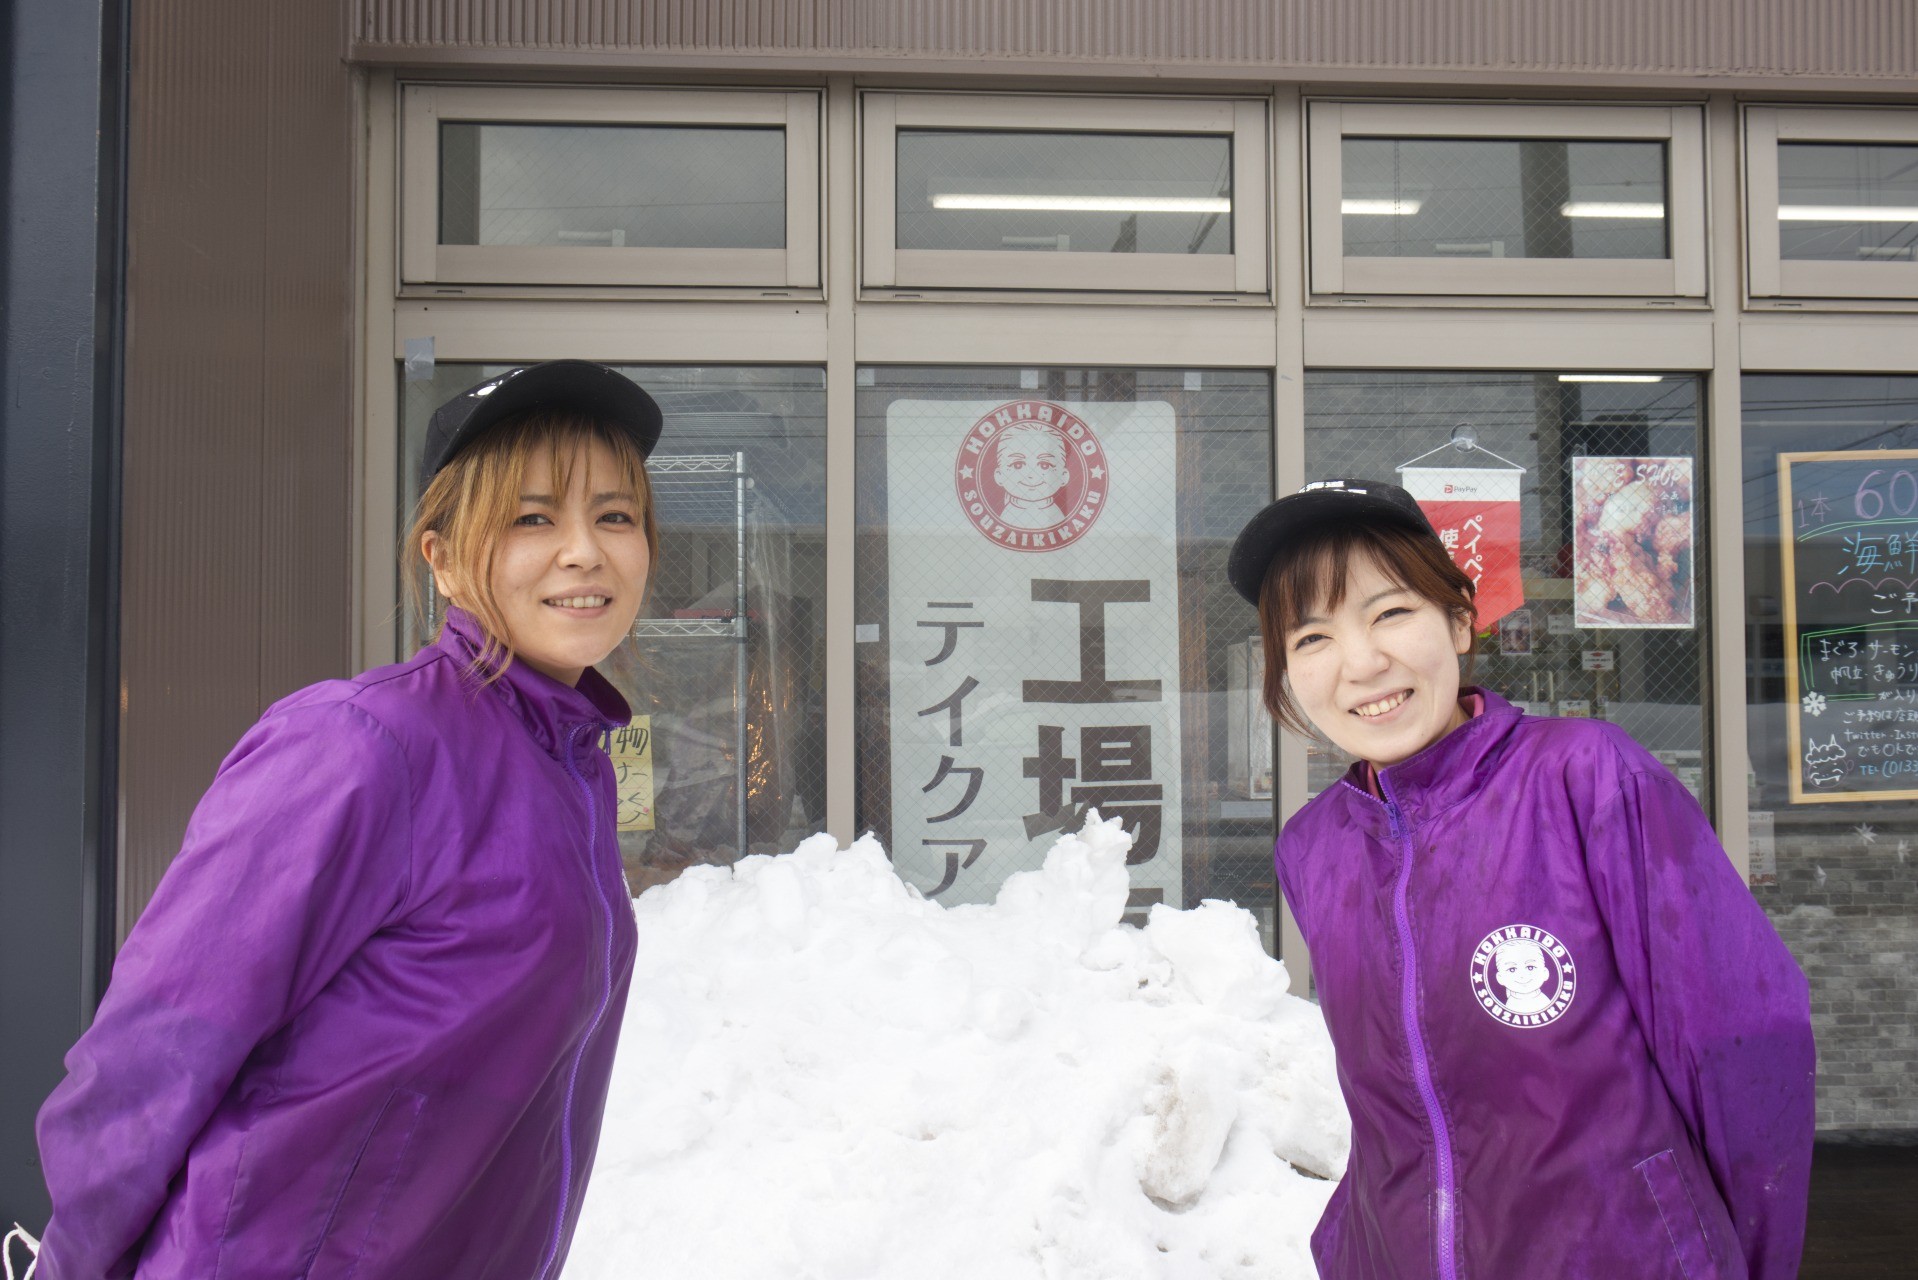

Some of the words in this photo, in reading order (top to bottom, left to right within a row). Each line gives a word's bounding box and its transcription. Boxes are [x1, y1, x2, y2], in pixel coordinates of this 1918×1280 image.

[965, 403, 1098, 456] HOKKAIDO
[1453, 485, 1477, 494] PayPay
[963, 489, 1101, 547] SOUZAIKIKAKU
[1022, 578, 1164, 930] 工場
[1474, 926, 1566, 966] HOKKAIDO
[1477, 980, 1574, 1026] SOUZAIKIKAKU
